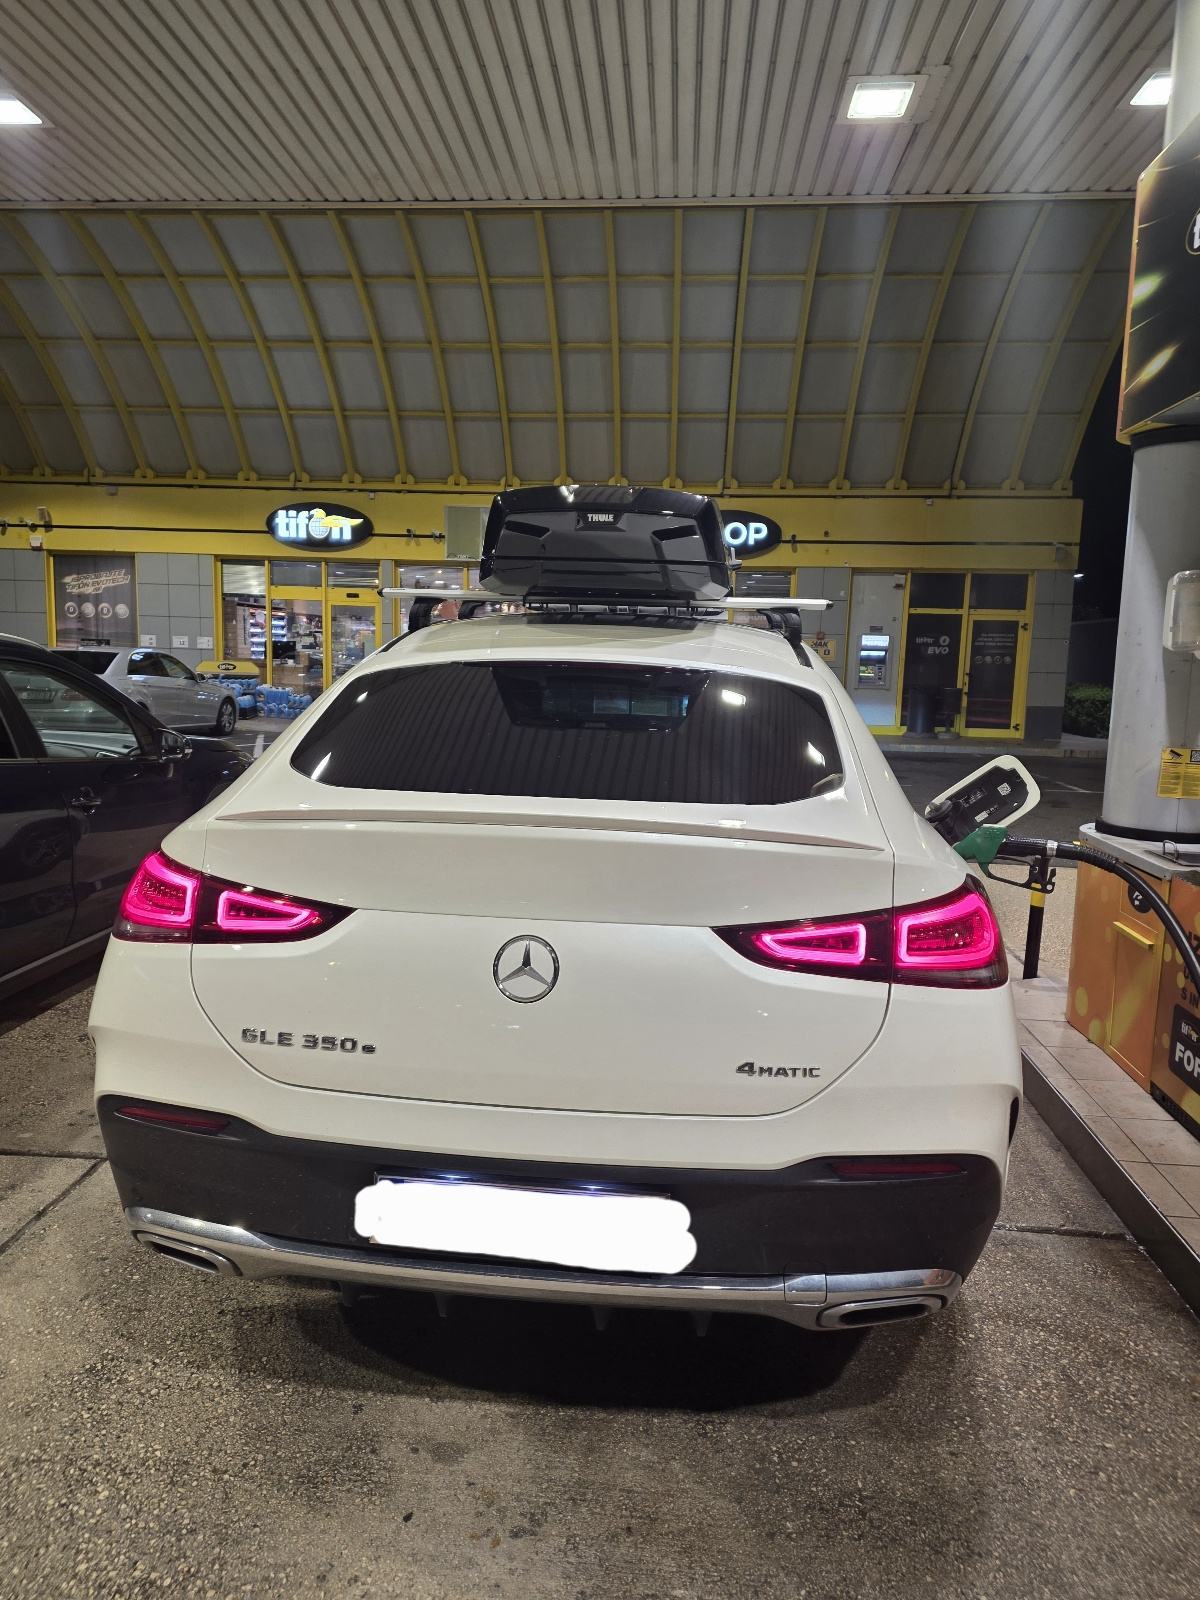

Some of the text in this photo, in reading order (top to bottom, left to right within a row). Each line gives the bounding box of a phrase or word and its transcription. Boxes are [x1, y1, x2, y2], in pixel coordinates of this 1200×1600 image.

[274, 508, 353, 540] tifon
[587, 513, 614, 522] THULE
[928, 646, 949, 655] EVO
[241, 1027, 295, 1048] GLE
[736, 1061, 821, 1078] 4MATIC
